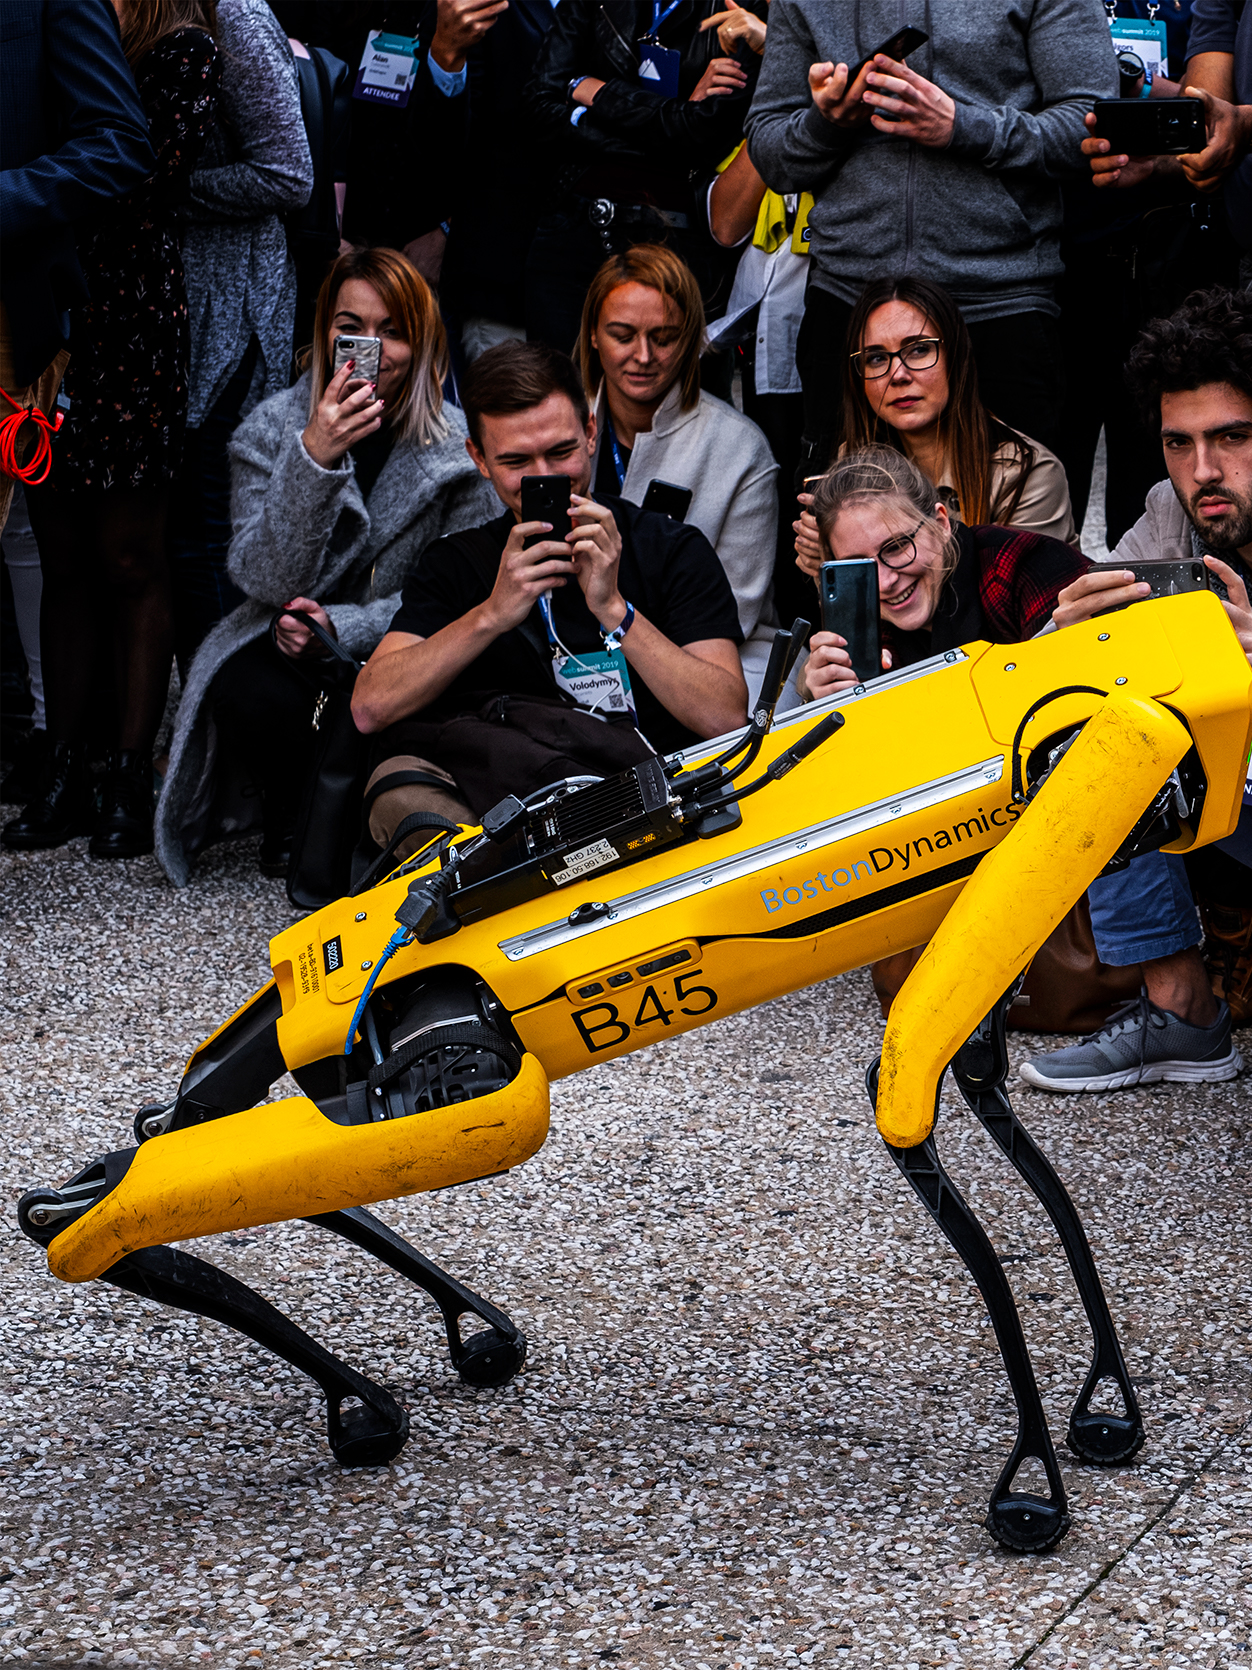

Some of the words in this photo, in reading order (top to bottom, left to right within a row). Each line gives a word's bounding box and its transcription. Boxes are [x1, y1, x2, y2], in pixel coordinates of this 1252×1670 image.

[372, 54, 388, 63] Alan
[363, 86, 400, 101] ATTENDEE
[602, 660, 618, 670] 2019
[569, 678, 617, 692] Volodymyr
[586, 840, 609, 856] 2.237
[555, 850, 617, 882] 192.168.50.106
[566, 854, 584, 863] GHz
[759, 803, 1020, 914] BostonDynamics
[570, 968, 719, 1053] B45
